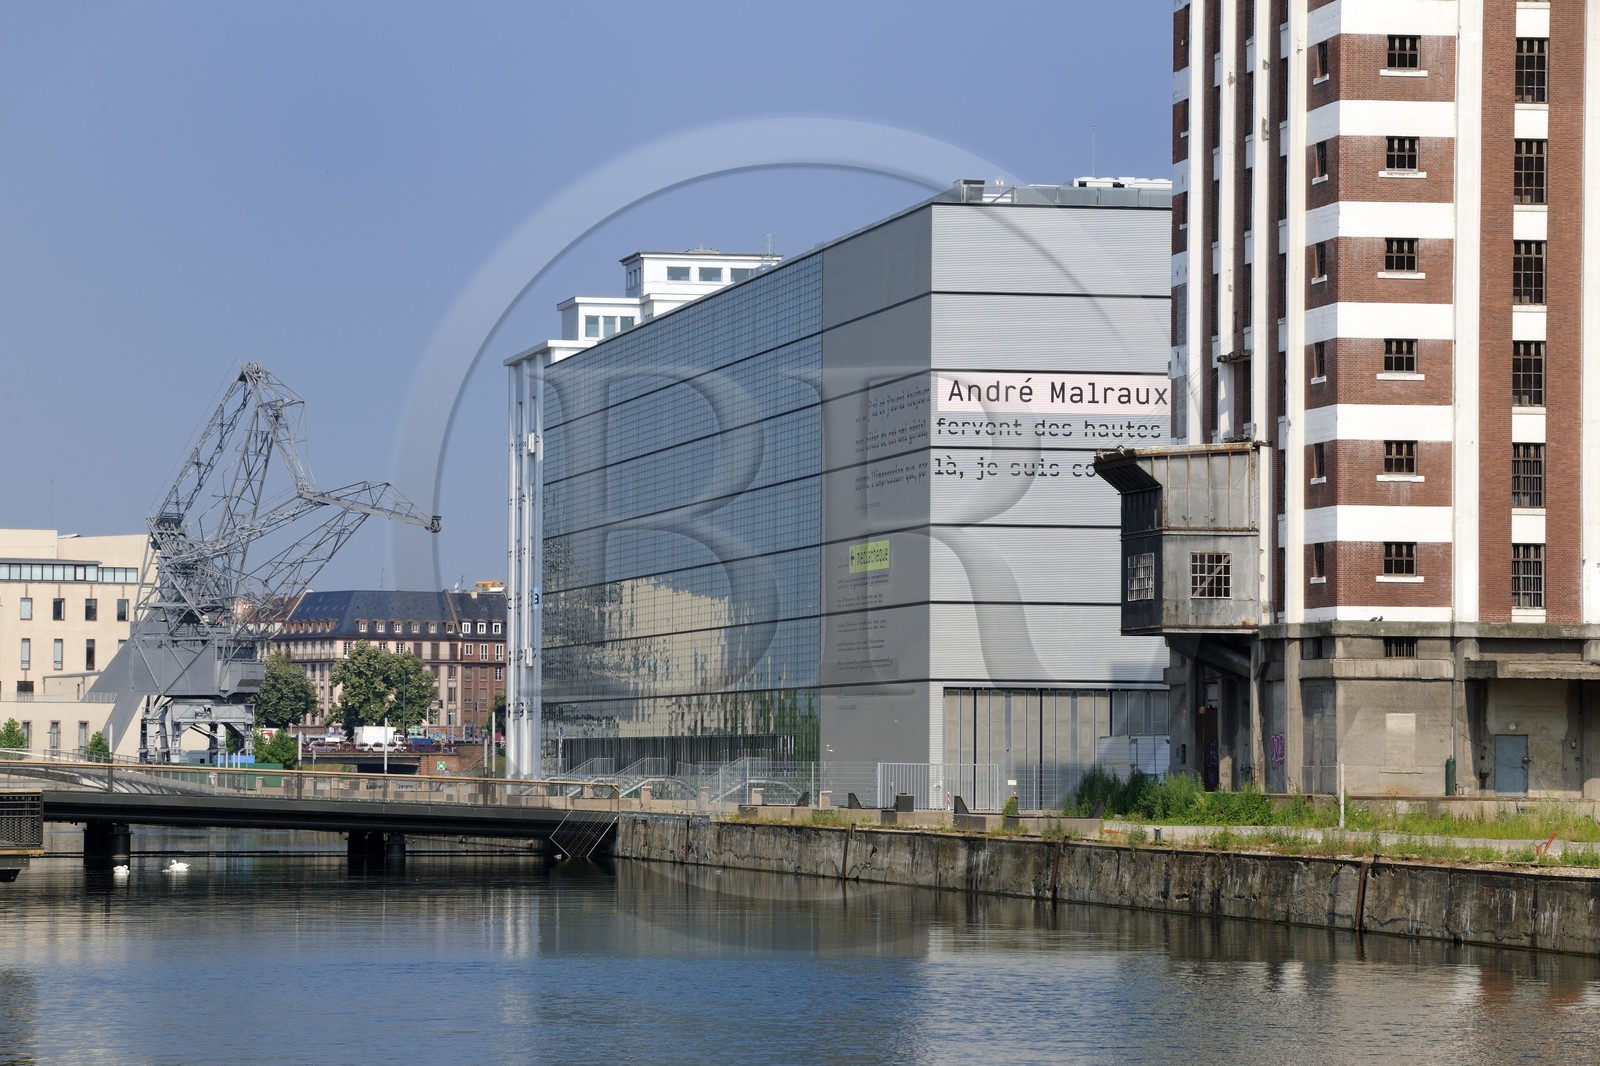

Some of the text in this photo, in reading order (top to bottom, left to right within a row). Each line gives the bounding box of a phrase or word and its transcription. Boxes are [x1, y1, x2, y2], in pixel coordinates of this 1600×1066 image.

[948, 377, 1033, 402] André
[1050, 382, 1168, 405] Malraux
[937, 418, 1022, 435] fervent
[1034, 420, 1073, 437] des
[1084, 421, 1161, 438] hautes
[934, 455, 964, 479] là,
[976, 457, 998, 480] je
[1010, 458, 1060, 477] suis
